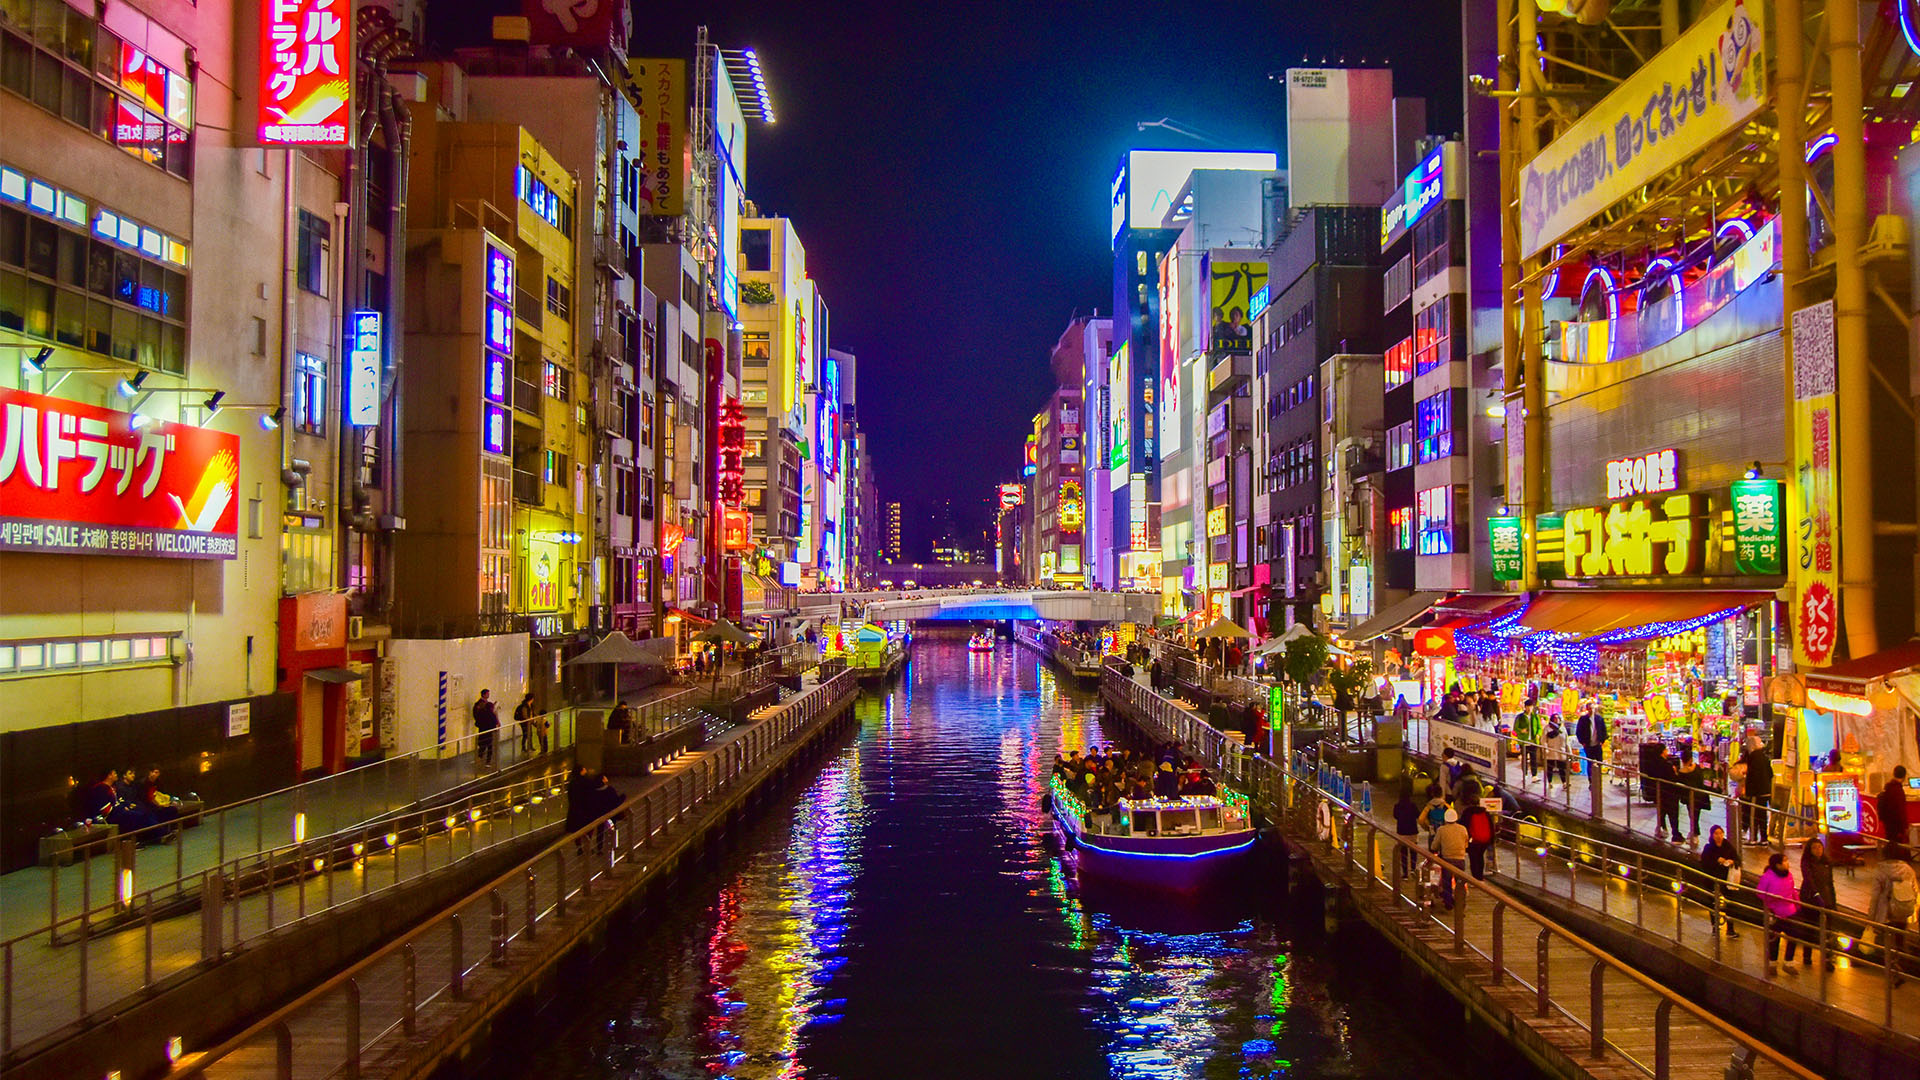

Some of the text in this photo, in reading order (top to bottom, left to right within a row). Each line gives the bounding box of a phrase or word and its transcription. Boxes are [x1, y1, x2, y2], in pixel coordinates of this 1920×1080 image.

[272, 0, 301, 100] ドラッグ
[304, 0, 341, 75] ルハ
[1737, 493, 1775, 532] 薬
[0, 522, 43, 545] 세일판매
[46, 524, 79, 547] SALE
[111, 529, 153, 551] 환영합니다
[156, 532, 206, 554] WELCOME
[1493, 526, 1519, 553] 薬
[1738, 534, 1776, 542] Medicine
[1806, 595, 1830, 624] すぐ
[1806, 624, 1830, 653] そこ
